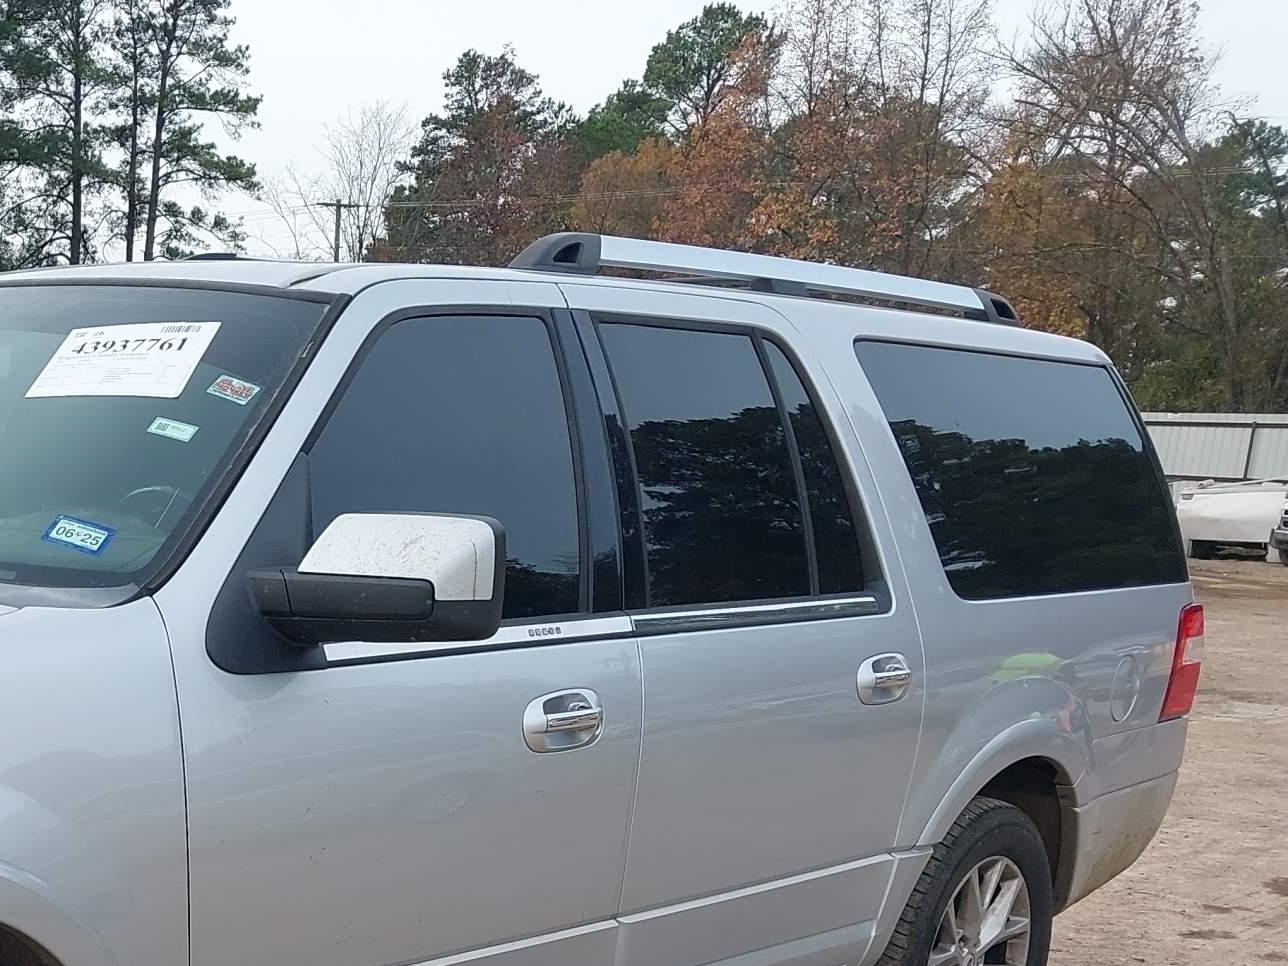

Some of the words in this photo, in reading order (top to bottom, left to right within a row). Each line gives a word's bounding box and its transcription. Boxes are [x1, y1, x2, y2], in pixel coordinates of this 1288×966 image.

[71, 337, 188, 354] 43937761
[55, 526, 76, 538] 06
[80, 533, 102, 546] 25
